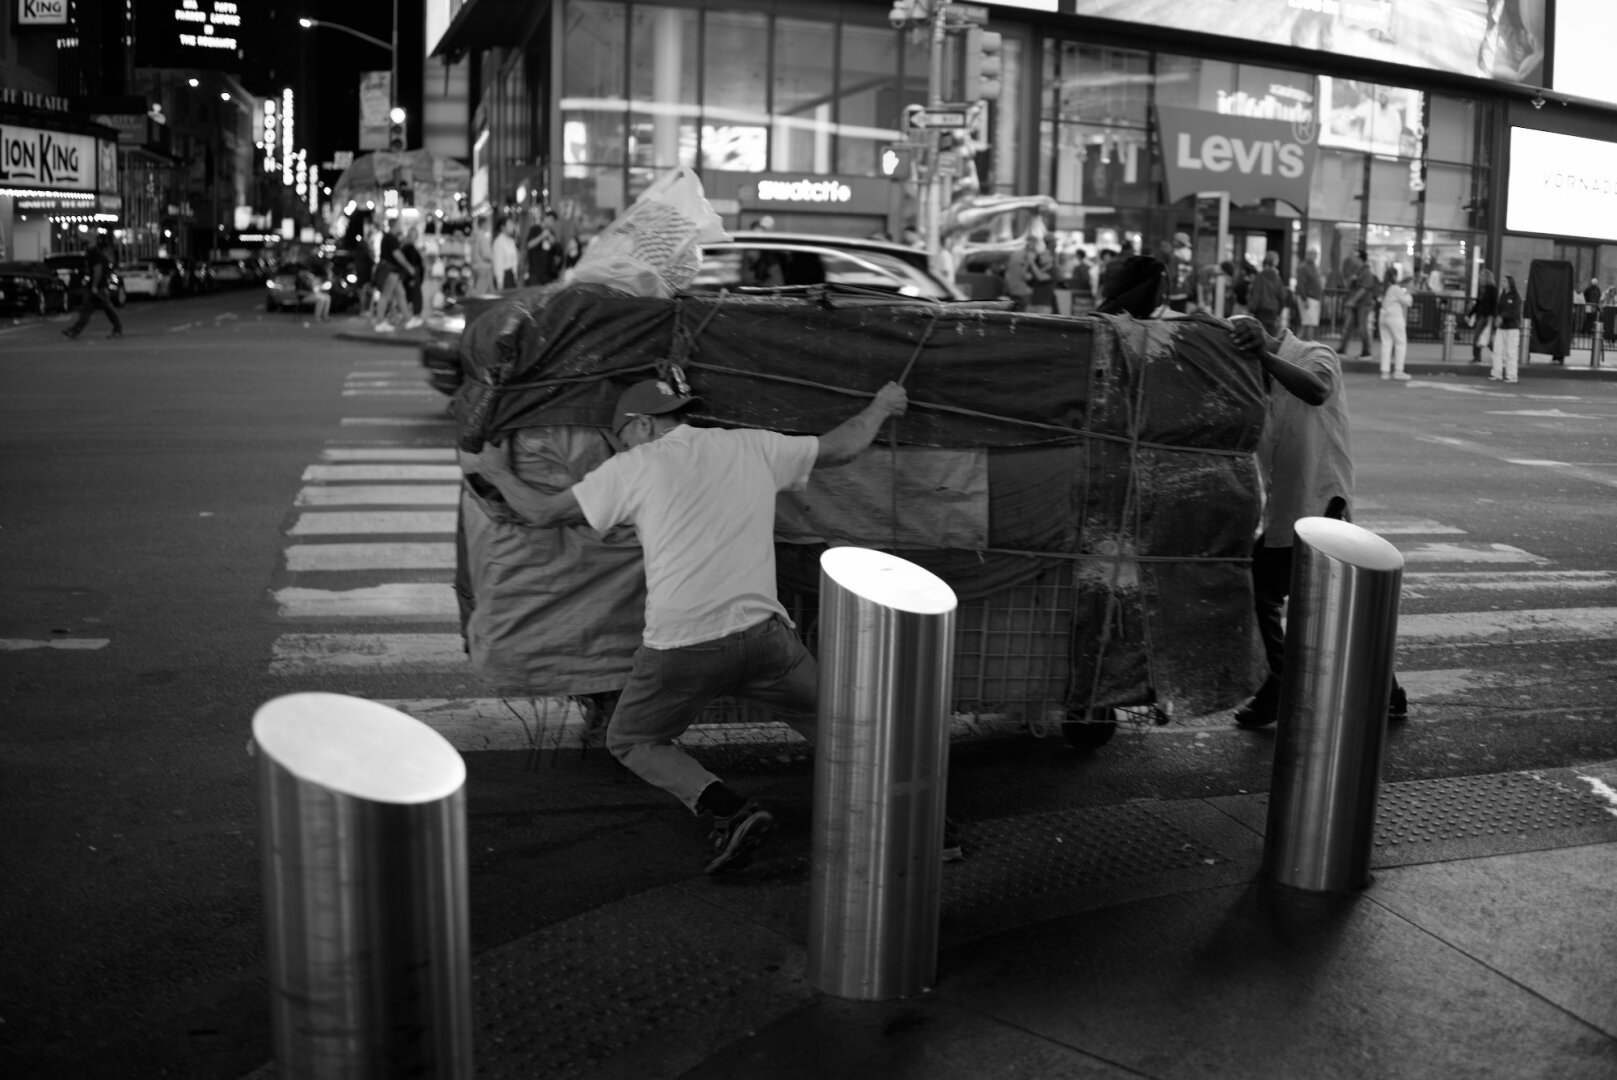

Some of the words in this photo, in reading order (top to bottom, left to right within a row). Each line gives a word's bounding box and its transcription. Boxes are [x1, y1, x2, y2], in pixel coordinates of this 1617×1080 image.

[24, 0, 62, 18] KING
[39, 133, 79, 185] KING
[758, 178, 840, 202] swatch
